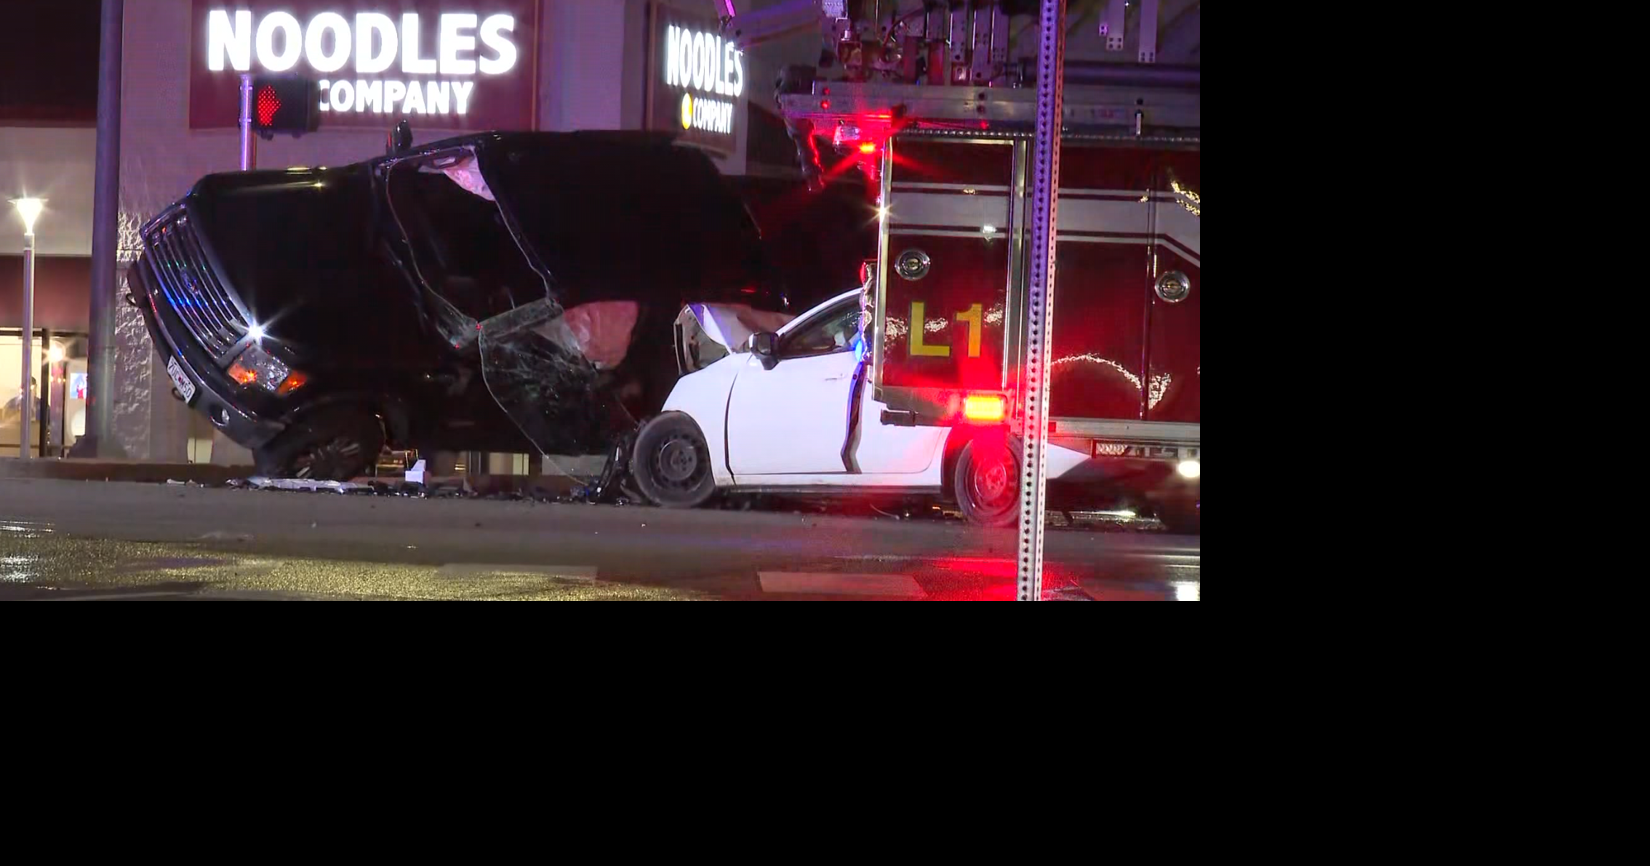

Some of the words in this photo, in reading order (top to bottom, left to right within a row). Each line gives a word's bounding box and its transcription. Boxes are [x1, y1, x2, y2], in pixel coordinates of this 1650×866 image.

[208, 10, 517, 74] NOODLES
[666, 25, 744, 98] NOODLES
[692, 97, 734, 134] COMPANY
[910, 301, 982, 357] L1
